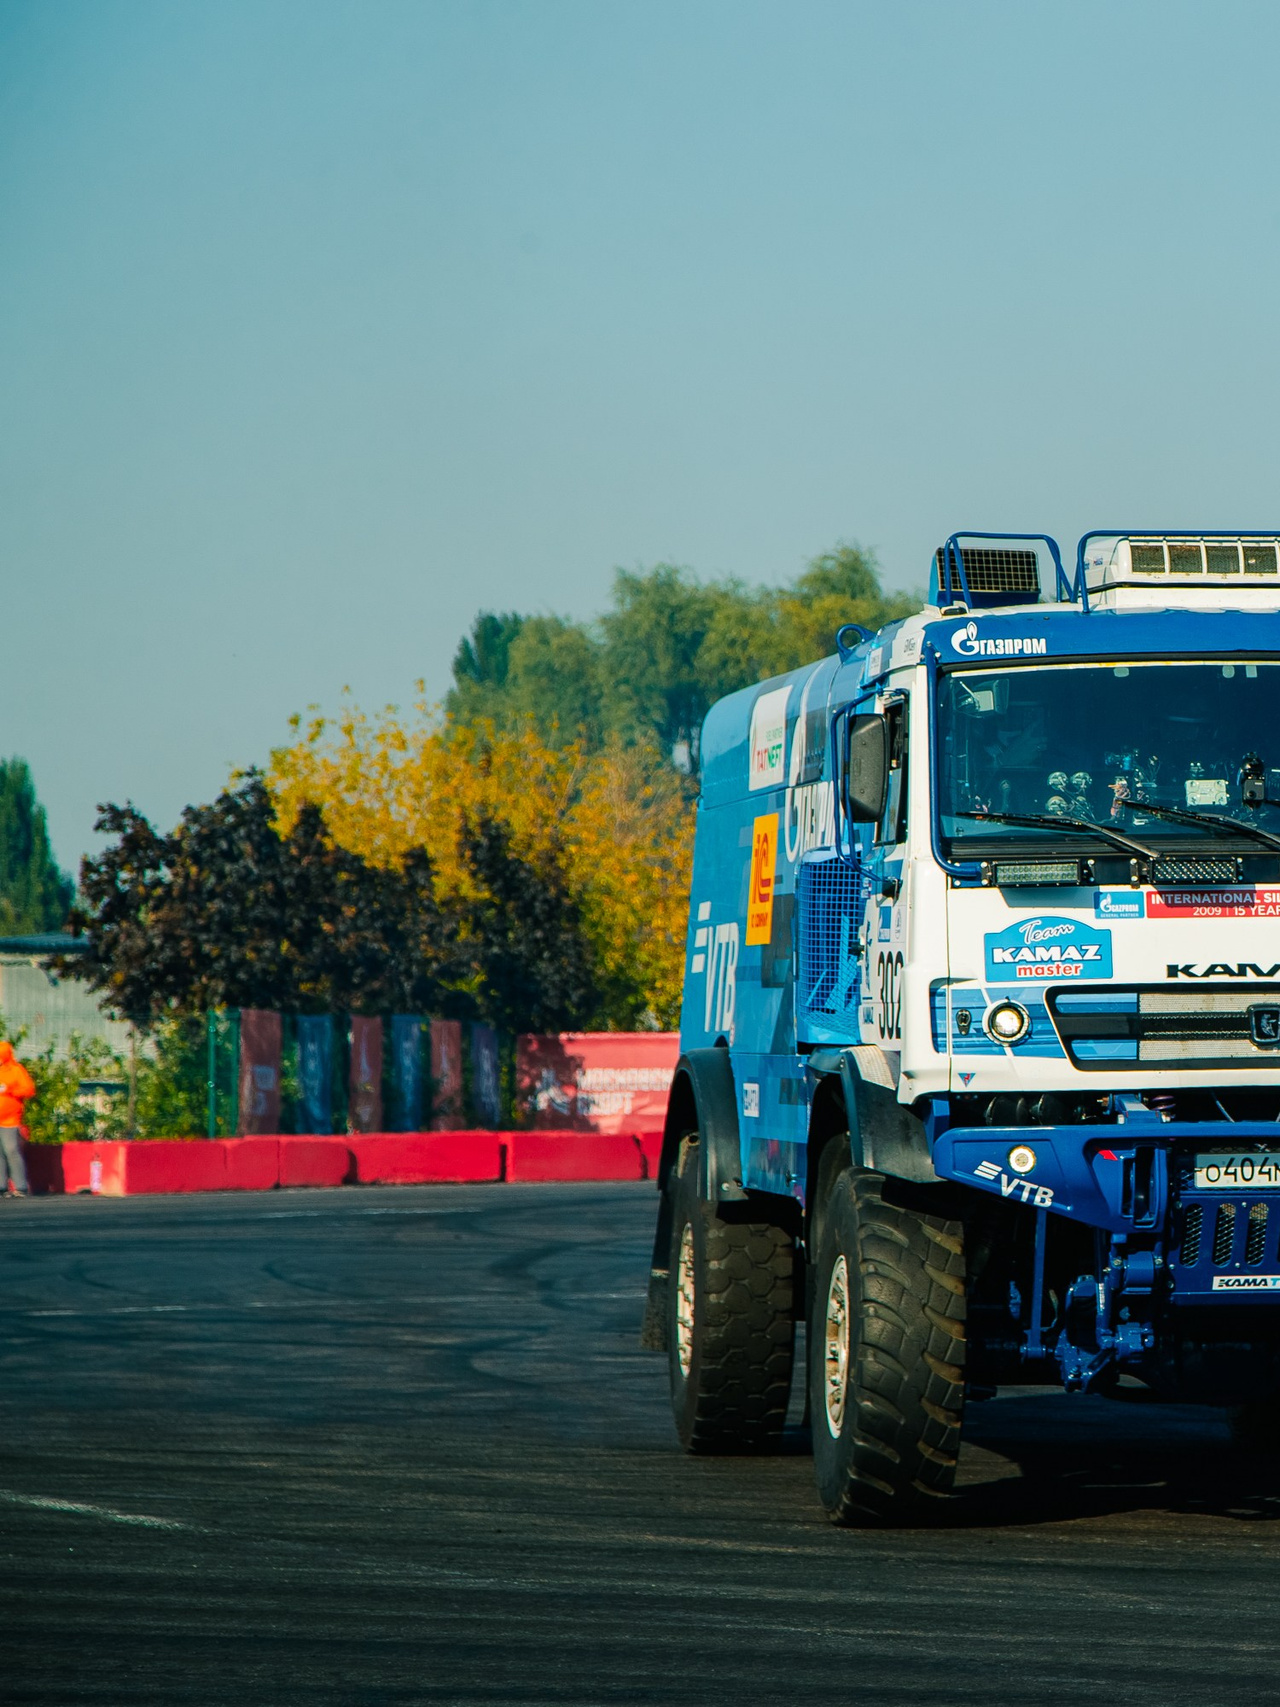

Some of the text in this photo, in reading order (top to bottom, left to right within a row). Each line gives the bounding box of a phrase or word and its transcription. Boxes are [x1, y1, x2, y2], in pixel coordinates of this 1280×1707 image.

[980, 638, 1047, 655] ГАЗПРОМ
[1151, 893, 1258, 905] INTERNATIONAL
[1193, 906, 1222, 916] 2009
[1233, 906, 1246, 916] 15
[1019, 919, 1075, 944] Team
[992, 944, 1102, 964] KAMAZ
[705, 922, 739, 1032] VTB
[1016, 963, 1083, 978] master
[1001, 1173, 1055, 1208] VTB
